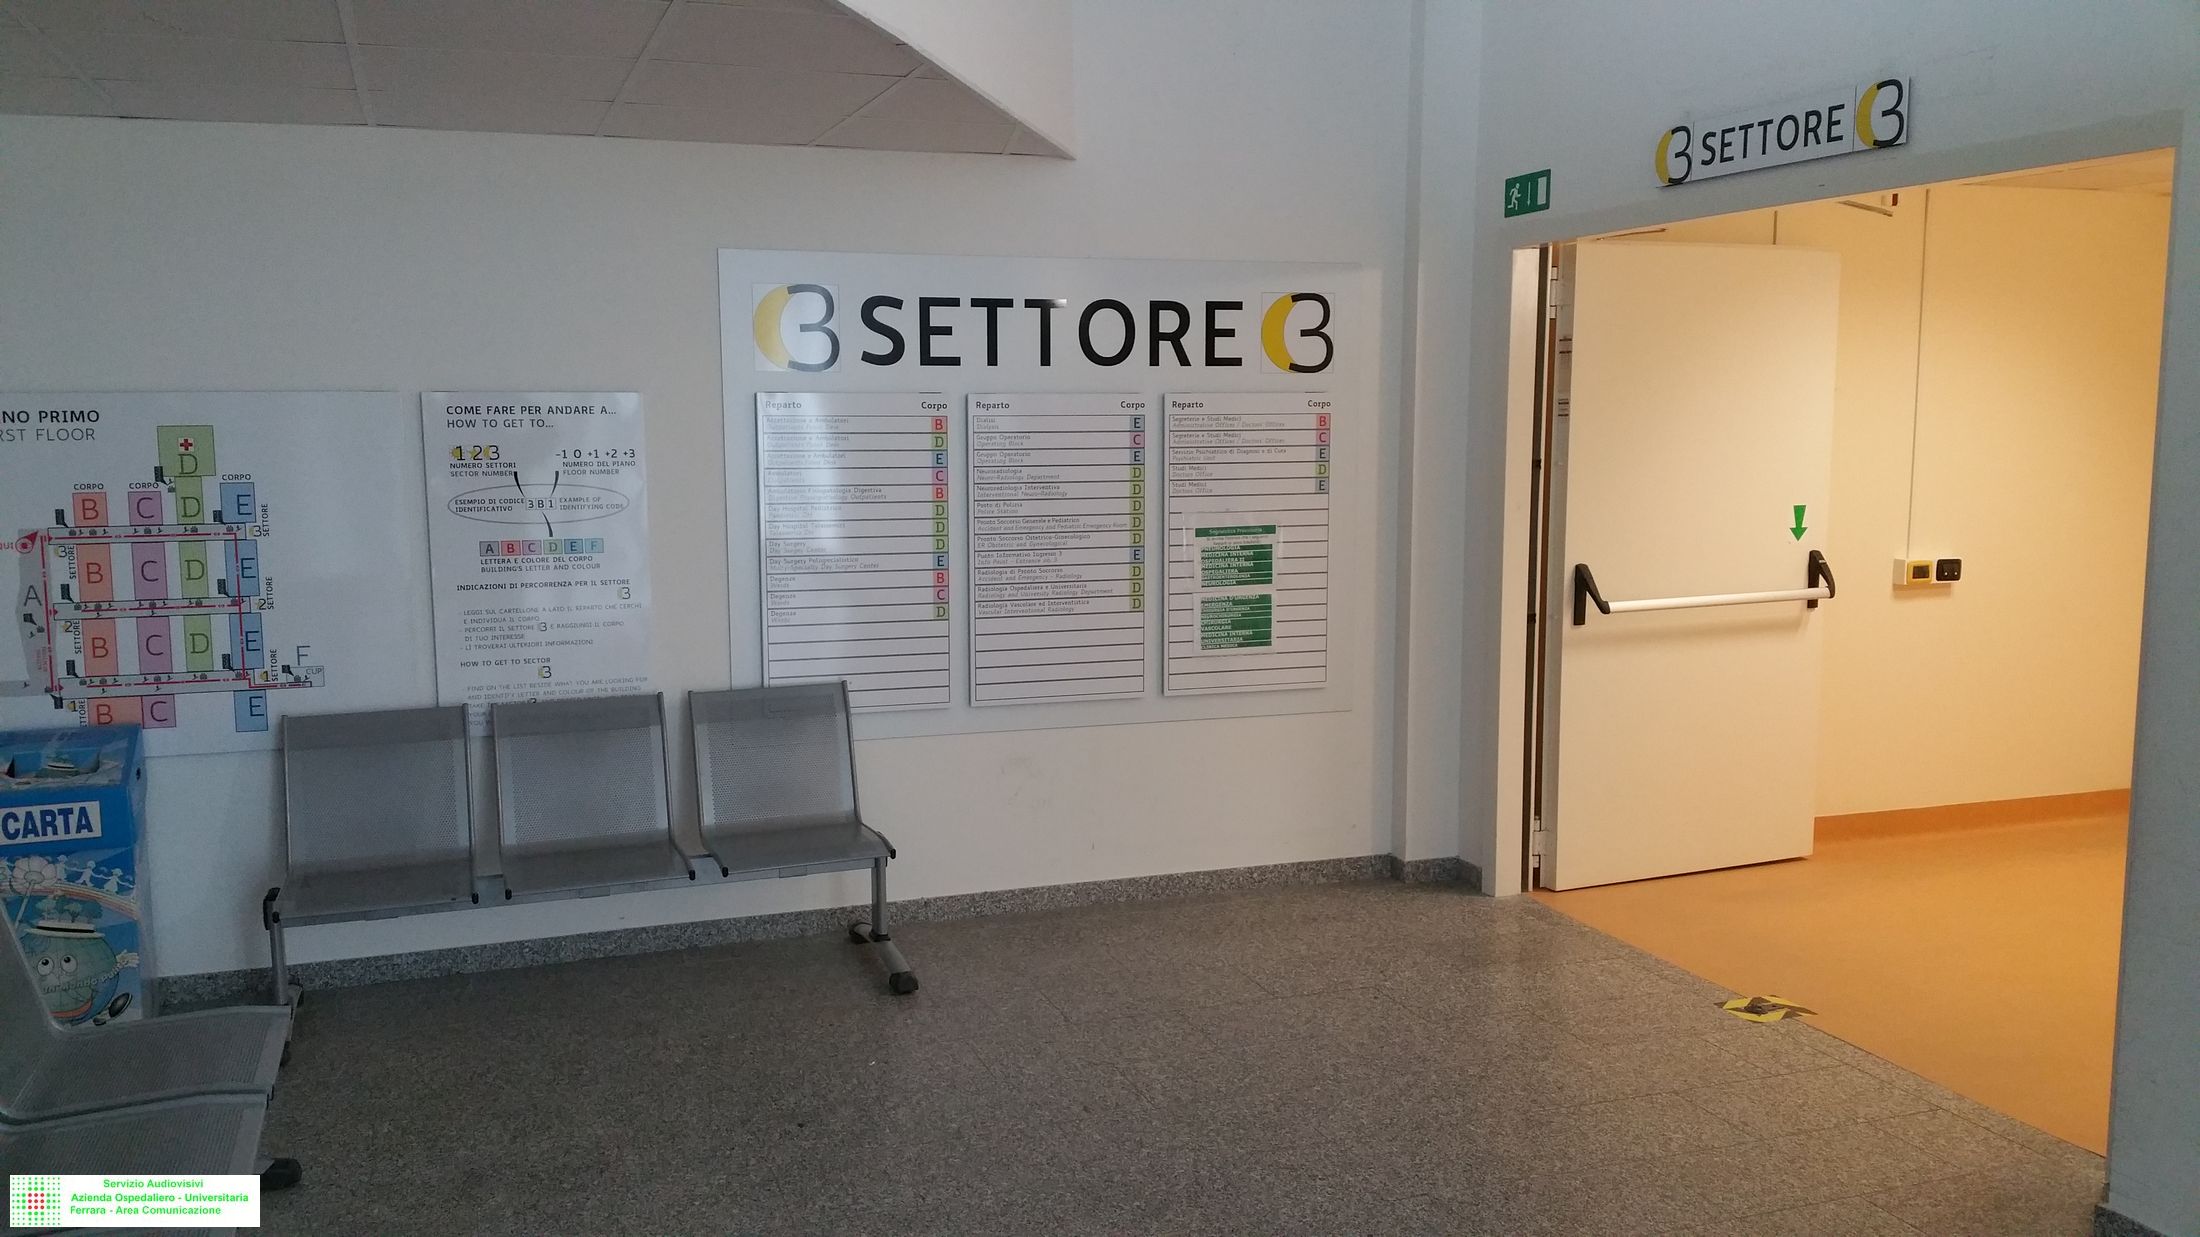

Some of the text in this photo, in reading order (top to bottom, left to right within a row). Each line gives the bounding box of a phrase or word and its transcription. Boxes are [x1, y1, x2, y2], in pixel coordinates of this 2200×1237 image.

[1701, 104, 1845, 165] SETTORE
[861, 295, 1243, 367] SETTORE
[765, 401, 802, 410] Reparto
[921, 402, 948, 411] Corpo
[975, 402, 1010, 411] Reparto
[1120, 401, 1145, 410] Corpo
[1172, 401, 1204, 410] Reparto
[1307, 400, 1331, 409] Corpo
[446, 406, 616, 415] COME FARE PER ANDARE A...
[39, 410, 100, 423] PRIMO
[1319, 416, 1326, 426] B
[447, 419, 554, 428] HOW TO GET TO...
[935, 419, 943, 430] B
[1134, 418, 1141, 429] E
[36, 428, 95, 441] FLOOR
[1133, 434, 1141, 445] C
[1319, 432, 1327, 442] C
[935, 437, 944, 447] D
[456, 445, 500, 461] 1 2 3
[573, 449, 582, 459] 0
[588, 449, 600, 459] +1
[605, 449, 618, 458] +2
[623, 449, 636, 458] +3
[1134, 451, 1141, 462] E
[1319, 448, 1326, 459] E
[179, 454, 199, 475] D
[936, 454, 944, 465] E
[1133, 468, 1141, 478] D
[1318, 464, 1327, 474] D
[935, 471, 944, 481] C
[73, 483, 104, 491] CORPO
[1133, 484, 1141, 495] D
[1319, 480, 1325, 490] E
[935, 488, 944, 498] B
[82, 499, 99, 520] B
[136, 497, 153, 519] C
[181, 496, 201, 518] D
[236, 494, 252, 515] E
[527, 500, 554, 509] 3 B 1
[1133, 500, 1141, 511] D
[936, 505, 944, 516] D
[262, 503, 270, 537] SETTORE
[1133, 517, 1141, 528] D
[253, 525, 262, 537] 3
[936, 522, 945, 533] D
[936, 539, 945, 550] D
[1133, 534, 1141, 544] D
[59, 546, 68, 558] 3
[486, 541, 598, 554] A B C D E F
[1134, 550, 1141, 560] E
[68, 544, 77, 580] SETTORE
[937, 556, 944, 567] E
[86, 562, 103, 584] B
[140, 560, 158, 581] C
[185, 560, 205, 581] D
[241, 558, 256, 578] E
[1132, 566, 1141, 577] D
[937, 572, 945, 584] B
[457, 583, 506, 591] INDICAZIONI
[520, 581, 572, 589] PERCORRENZA
[1132, 583, 1141, 593] D
[24, 585, 42, 606] A
[622, 587, 631, 600] 3
[936, 590, 945, 600] C
[258, 598, 267, 610] 2
[1132, 599, 1141, 609] D
[937, 607, 945, 618] D
[65, 621, 73, 633] 2
[73, 619, 82, 655] SETTORE
[245, 631, 260, 651] E
[92, 637, 109, 658] B
[146, 635, 163, 656] C
[189, 633, 209, 654] D
[297, 645, 311, 666] F
[524, 657, 551, 665] SECTOR
[542, 665, 552, 679] 3
[150, 701, 167, 721] C
[249, 696, 265, 717] E
[97, 704, 113, 725] B
[1, 806, 94, 840] CARTA
